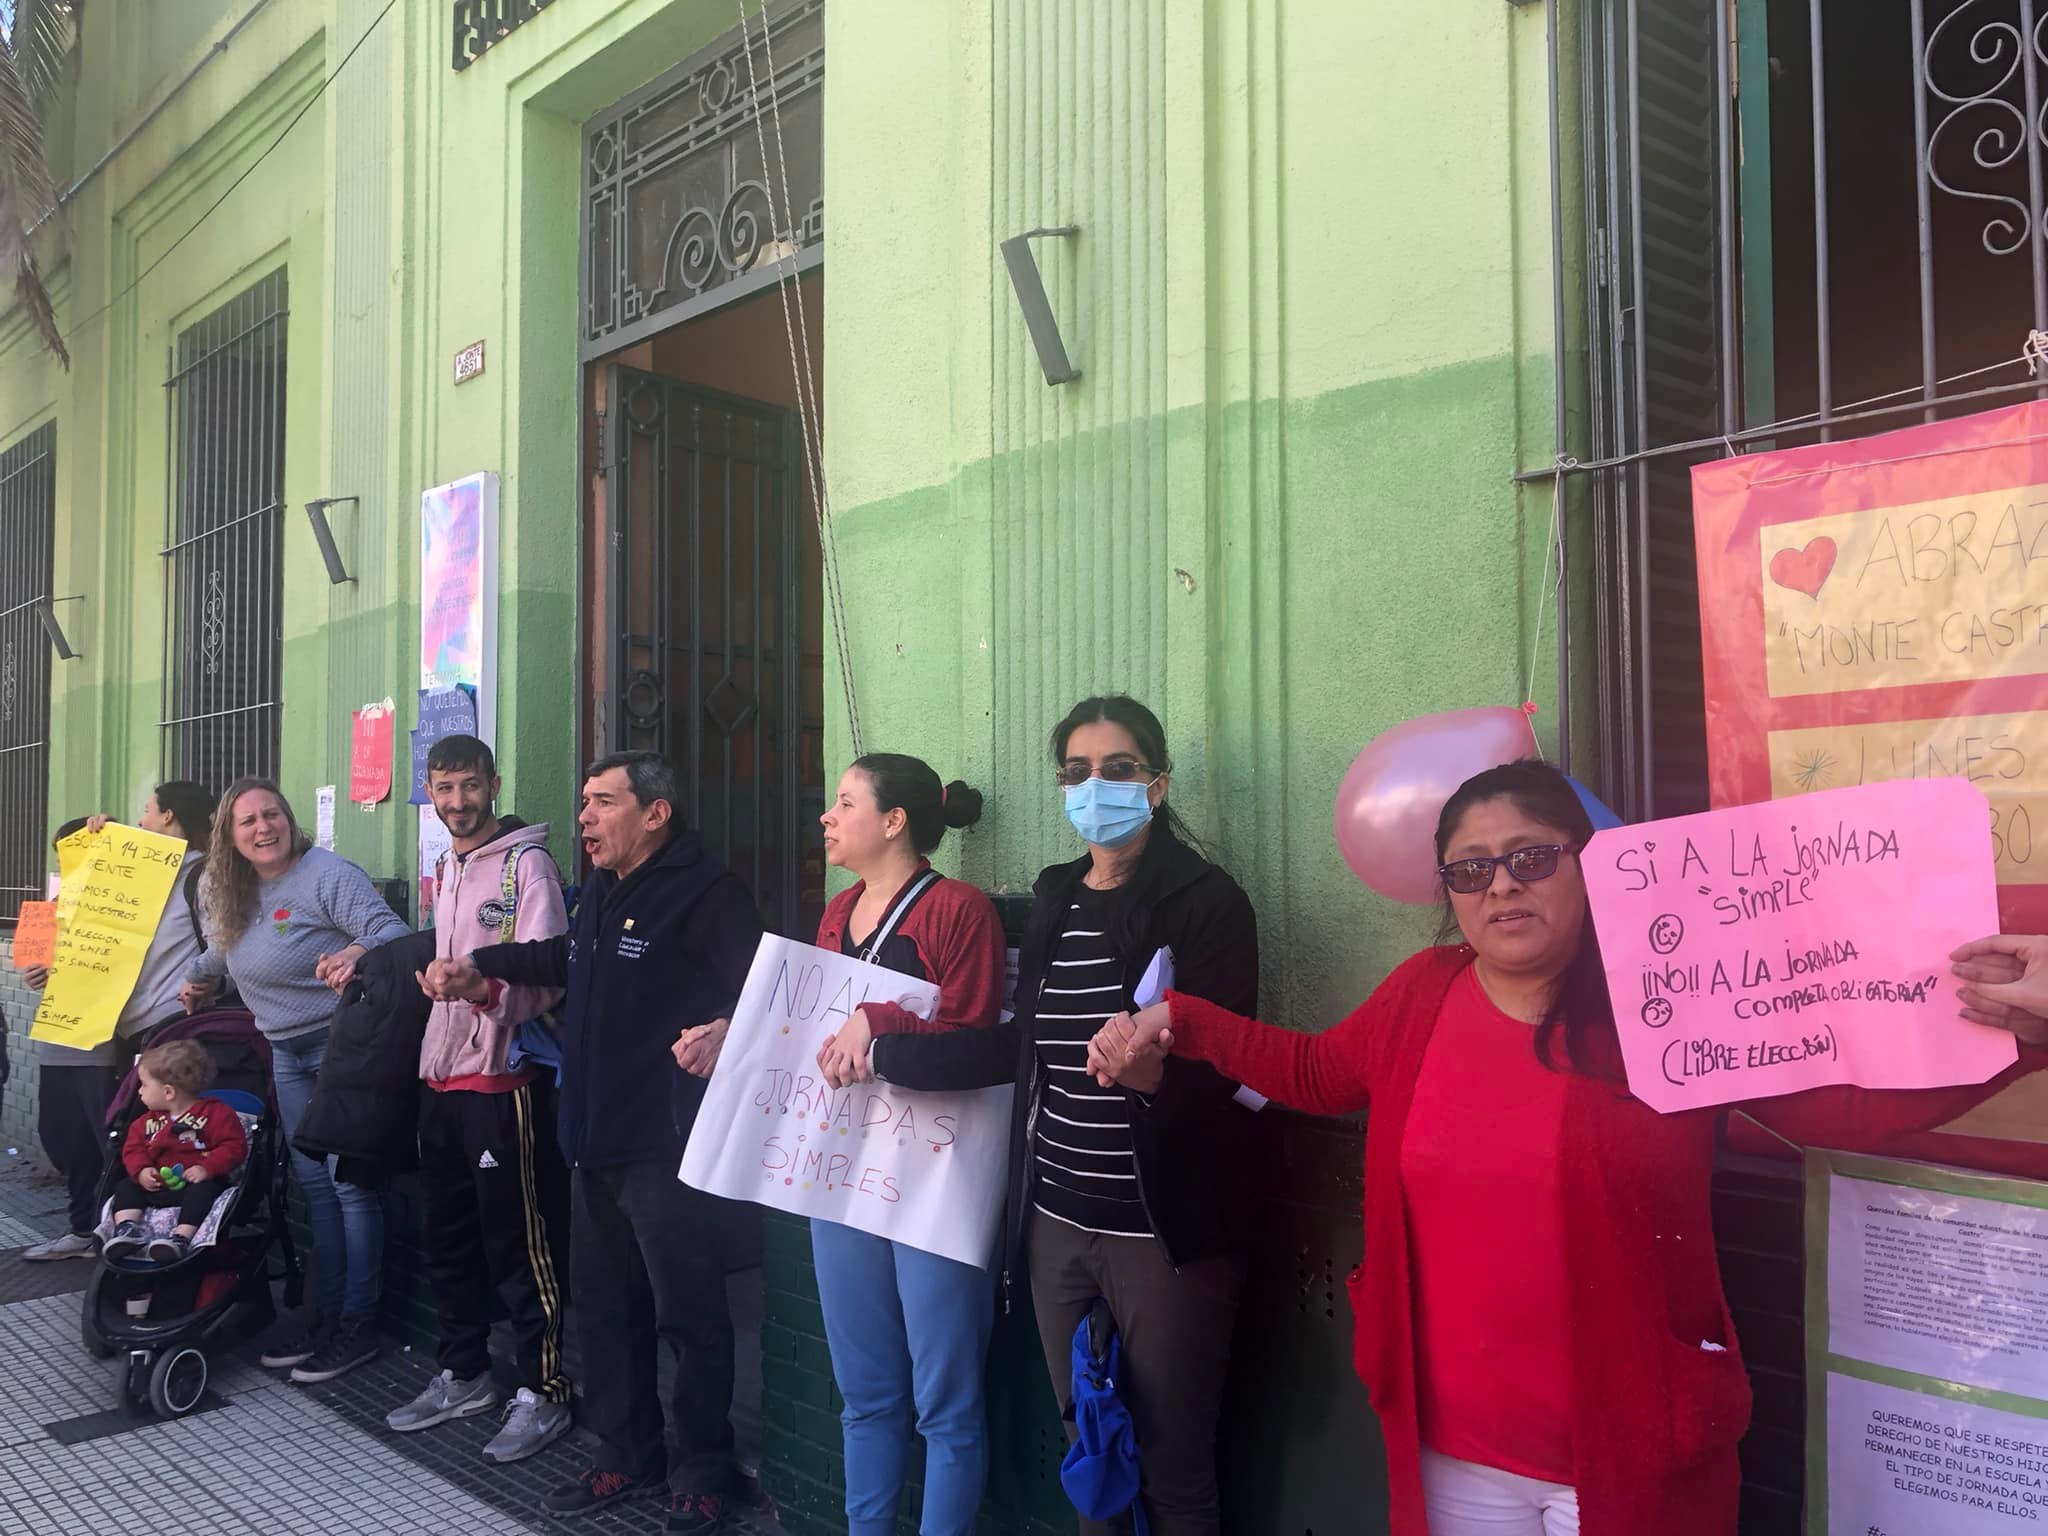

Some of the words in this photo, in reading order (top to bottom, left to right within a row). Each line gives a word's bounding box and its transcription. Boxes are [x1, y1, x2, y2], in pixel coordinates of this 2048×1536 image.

[1681, 837, 1709, 879] A
[1730, 829, 1768, 877] LA
[1710, 959, 1732, 995] A
[1741, 950, 1772, 988] LA
[755, 1068, 956, 1146] JORNADAS
[762, 1134, 901, 1203] SIMPLES
[1866, 1424, 1922, 1446] DERECHO
[1925, 1437, 1941, 1451] DE
[1944, 1441, 2014, 1466] NUESTROS
[1872, 1410, 1941, 1434] QUEREMOS
[1944, 1426, 1971, 1441] QUE
[1975, 1433, 1991, 1446] SE
[1865, 1438, 1942, 1466] PERMANECER
[1945, 1459, 1963, 1472] EN
[1966, 1463, 1981, 1476] LA
[1985, 1467, 2042, 1489] ESCUELA
[1886, 1460, 1899, 1473] EL
[1904, 1464, 1934, 1480] TIPO
[1937, 1472, 1953, 1485] DE
[1956, 1476, 2018, 1500] JORNADA
[2022, 1492, 2048, 1507] QUE
[1894, 1478, 1959, 1503] ELEGIMOS
[1961, 1494, 1994, 1511] PARA
[1997, 1502, 2040, 1521] ELLOS.
